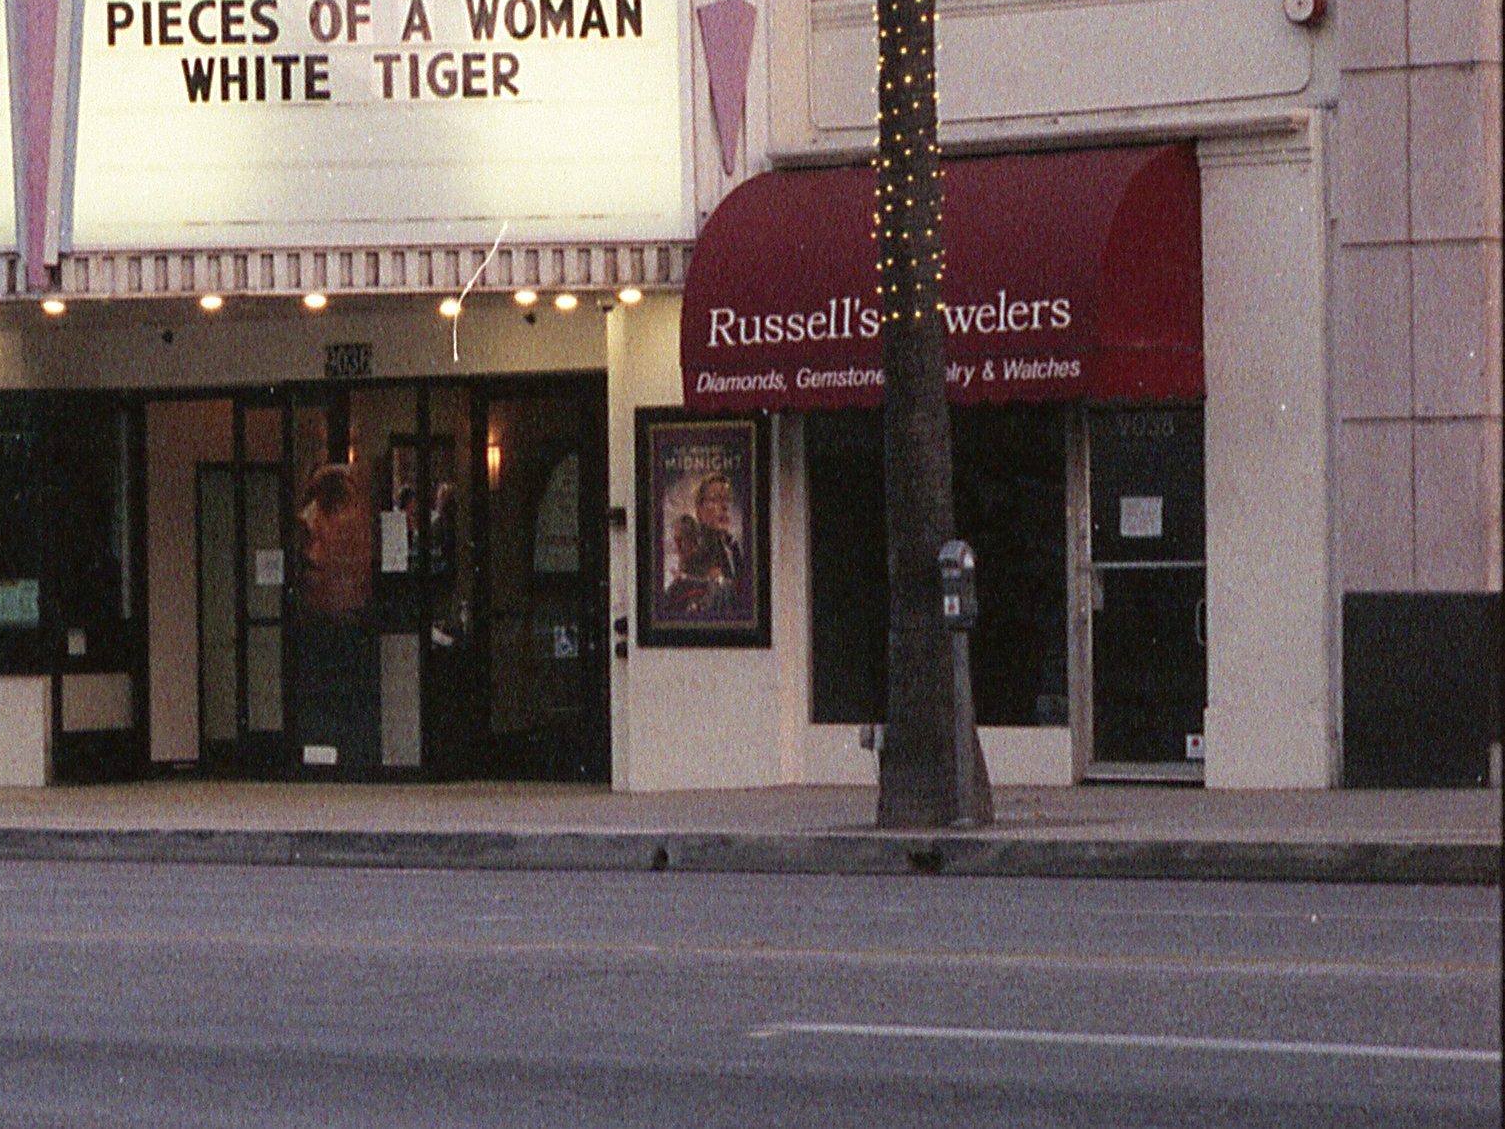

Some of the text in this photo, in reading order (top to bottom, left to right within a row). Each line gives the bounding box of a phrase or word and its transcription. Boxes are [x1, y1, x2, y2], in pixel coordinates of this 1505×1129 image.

[181, 52, 521, 103] WHITE TIGER
[707, 289, 1072, 347] Russell's welers
[696, 369, 788, 393] Diamonds,
[796, 367, 886, 389] Gemstone
[982, 359, 994, 381] &
[1003, 356, 1081, 381] Watches
